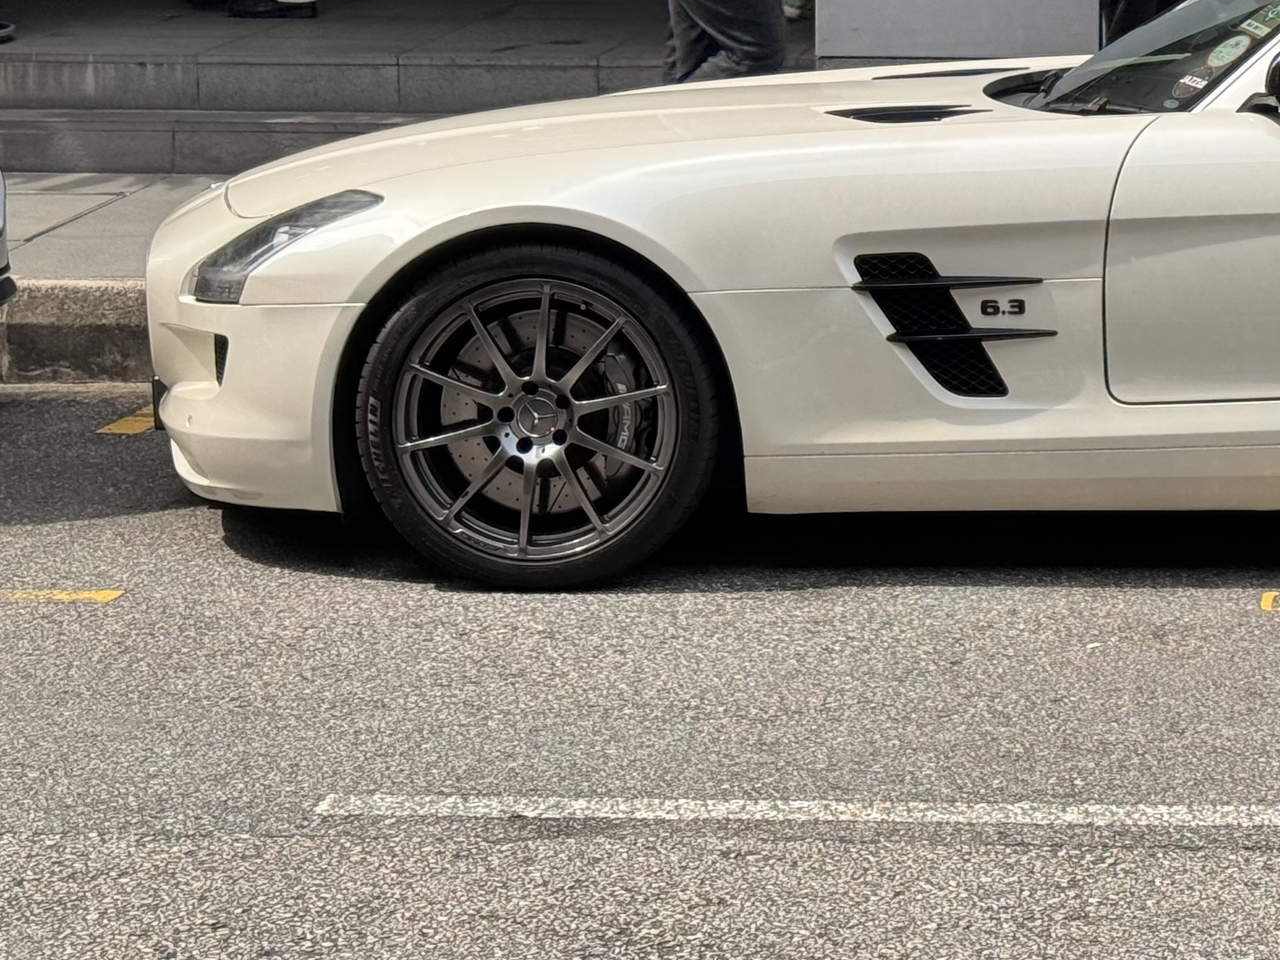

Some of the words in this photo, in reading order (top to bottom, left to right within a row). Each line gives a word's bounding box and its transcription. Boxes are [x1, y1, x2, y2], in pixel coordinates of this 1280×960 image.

[980, 298, 1026, 316] 6.3
[616, 403, 631, 450] AMG
[368, 395, 402, 506] MICHELIN
